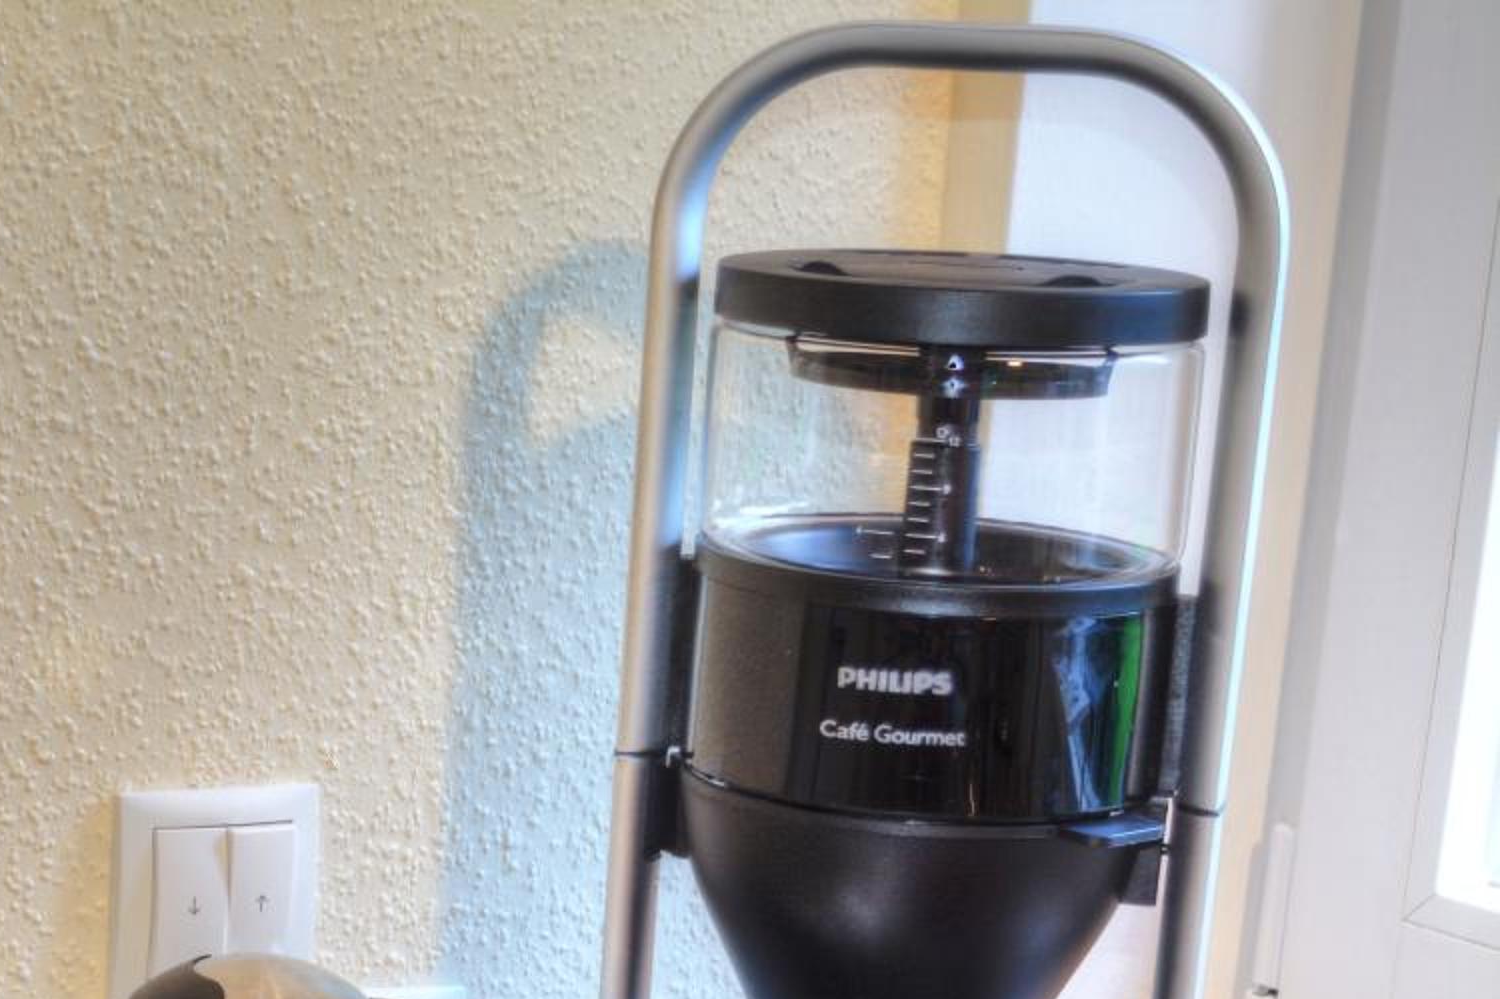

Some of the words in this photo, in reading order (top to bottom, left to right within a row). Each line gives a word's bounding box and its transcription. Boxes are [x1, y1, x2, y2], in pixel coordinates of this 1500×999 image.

[837, 666, 953, 696] PHILIPS
[819, 719, 869, 742] Café
[874, 724, 966, 747] Gourmet
